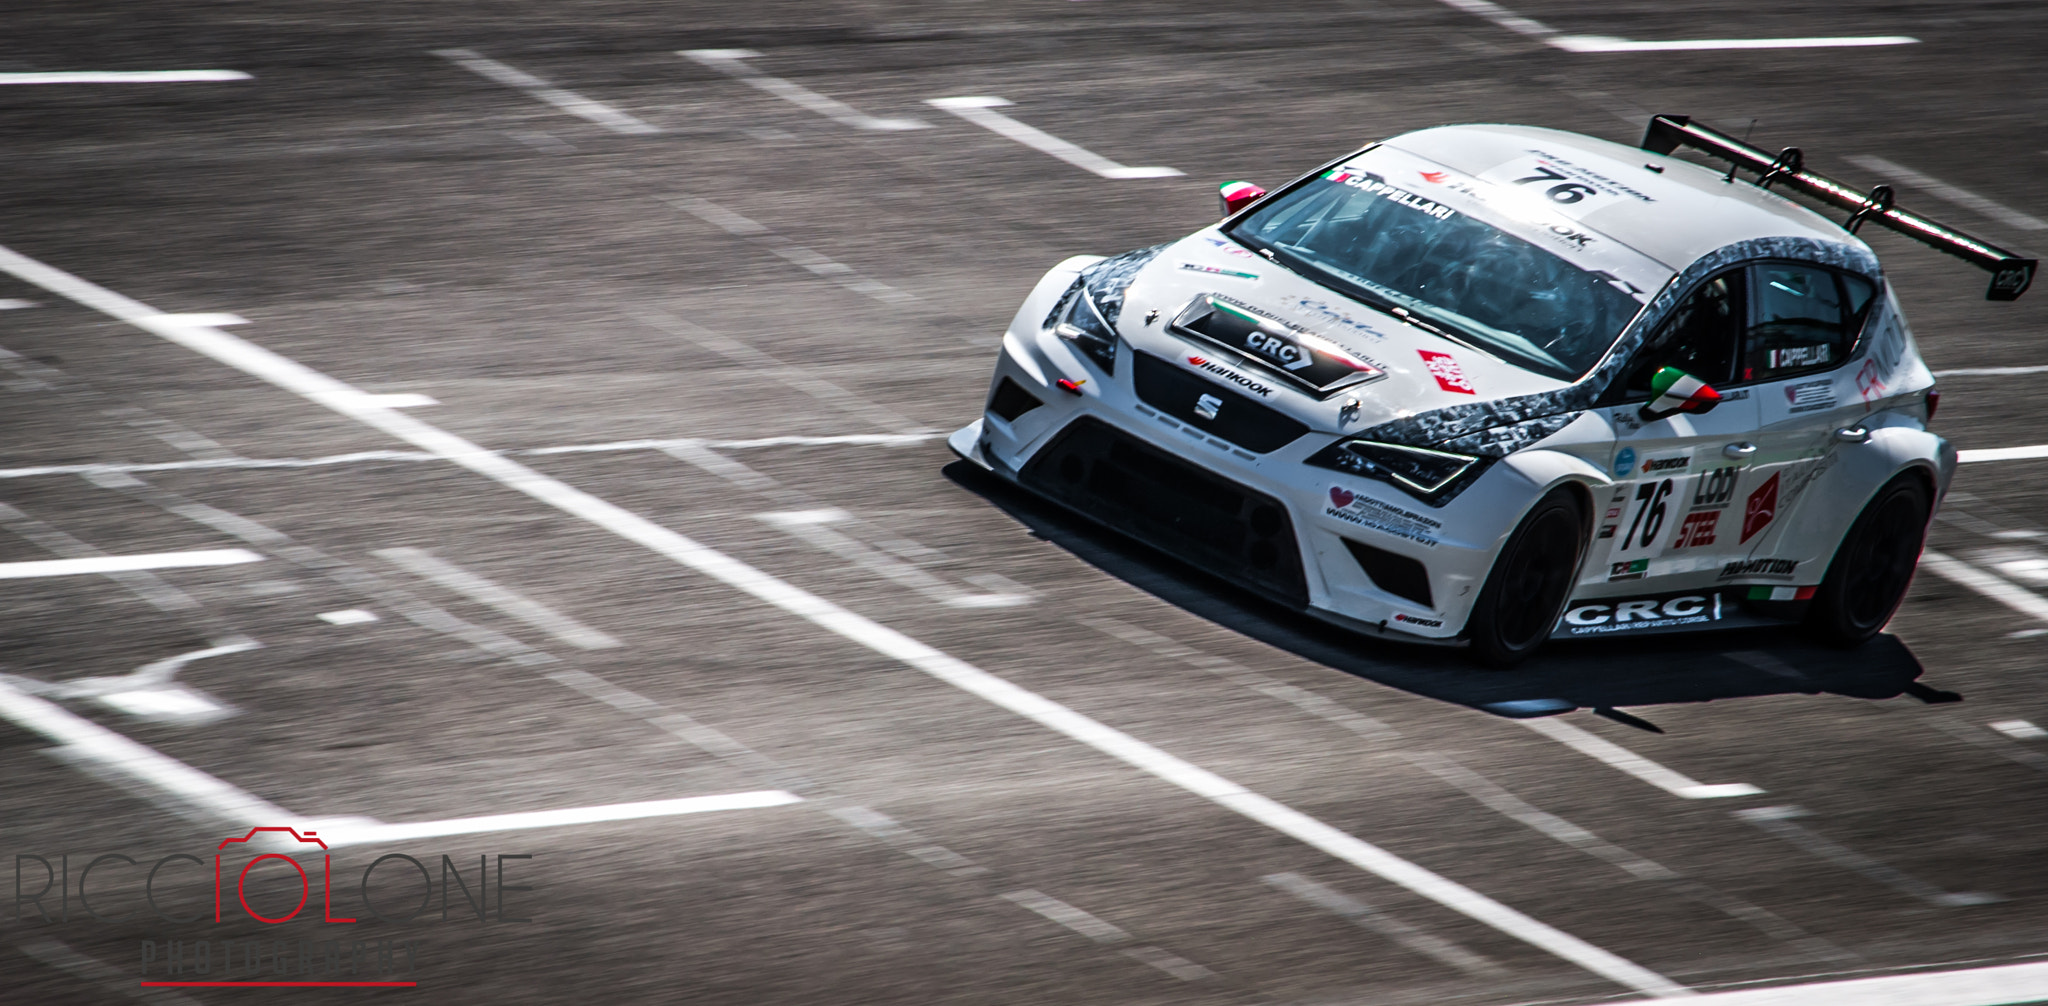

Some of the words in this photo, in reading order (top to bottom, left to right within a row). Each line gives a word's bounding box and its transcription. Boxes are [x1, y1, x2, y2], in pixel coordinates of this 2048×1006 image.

[1345, 176, 1456, 220] CAPPELLARI
[1513, 166, 1596, 204] 76
[1247, 331, 1300, 361] CRC
[1693, 466, 1741, 505] LODI
[1621, 478, 1673, 551] 76
[1674, 510, 1721, 549] STEEL
[1565, 596, 1706, 625] CRC
